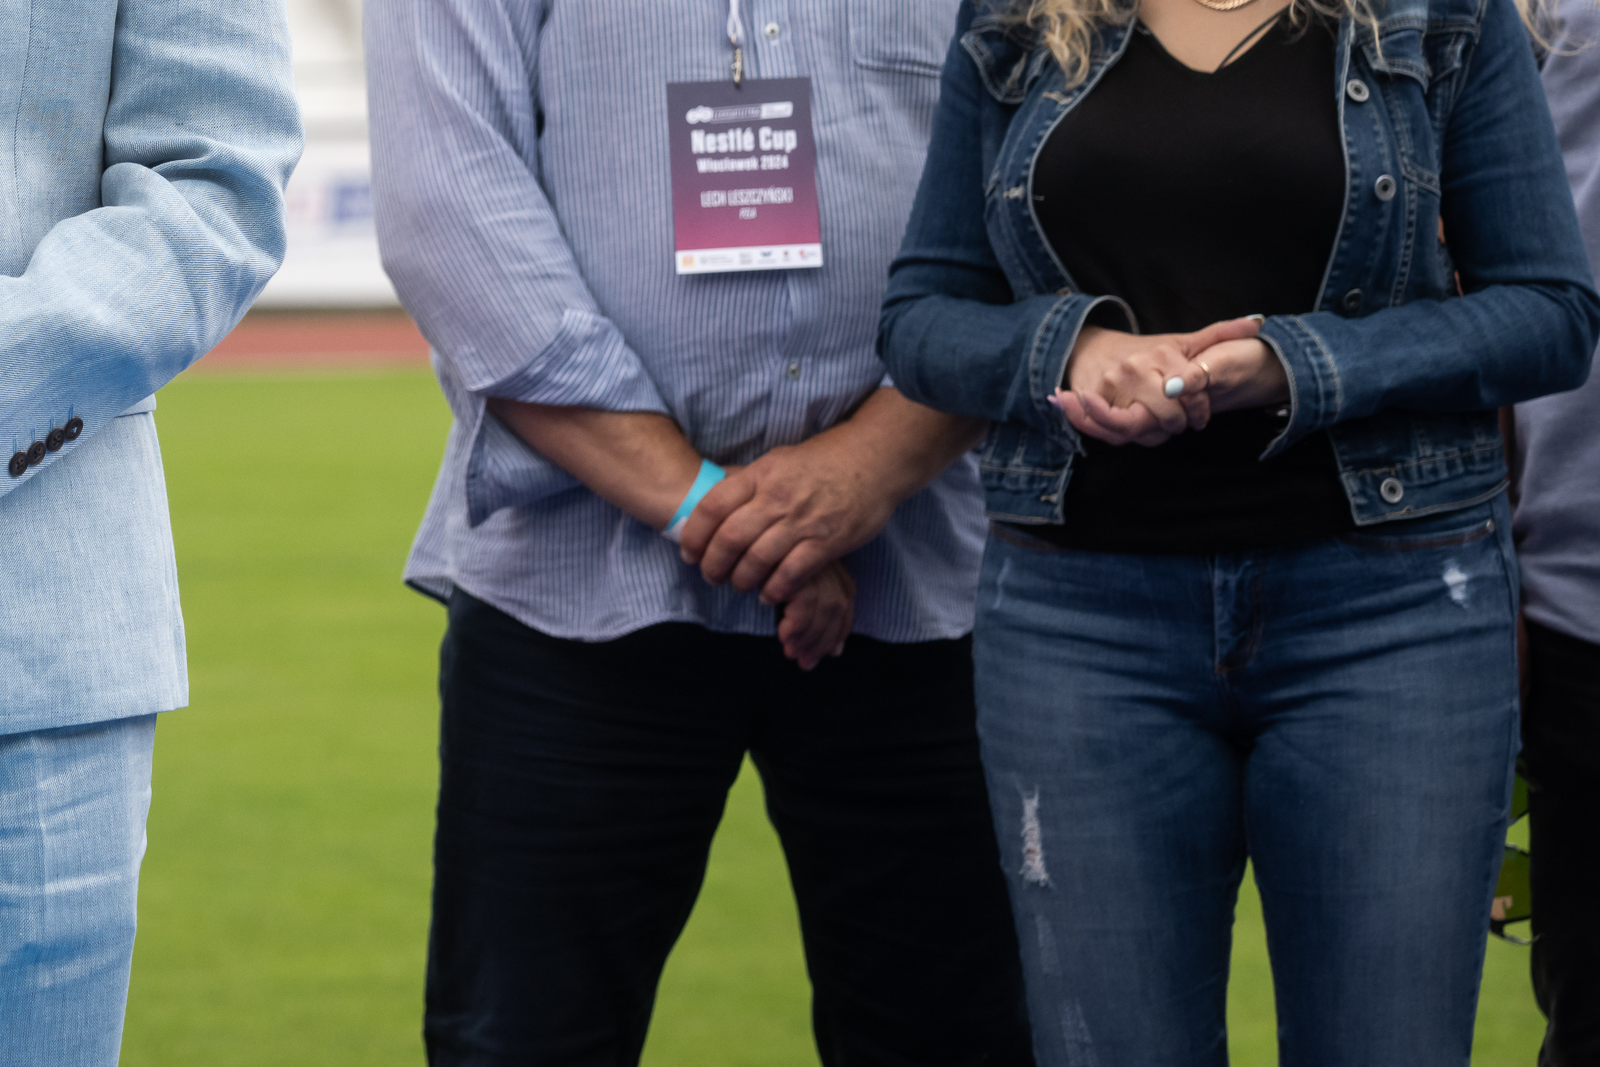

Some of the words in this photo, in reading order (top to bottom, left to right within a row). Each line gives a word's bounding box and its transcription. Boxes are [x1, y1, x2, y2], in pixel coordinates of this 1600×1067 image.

[691, 126, 755, 154] Nestlé
[759, 125, 797, 153] Cup
[760, 153, 789, 170] 2024
[700, 190, 727, 208] LECH
